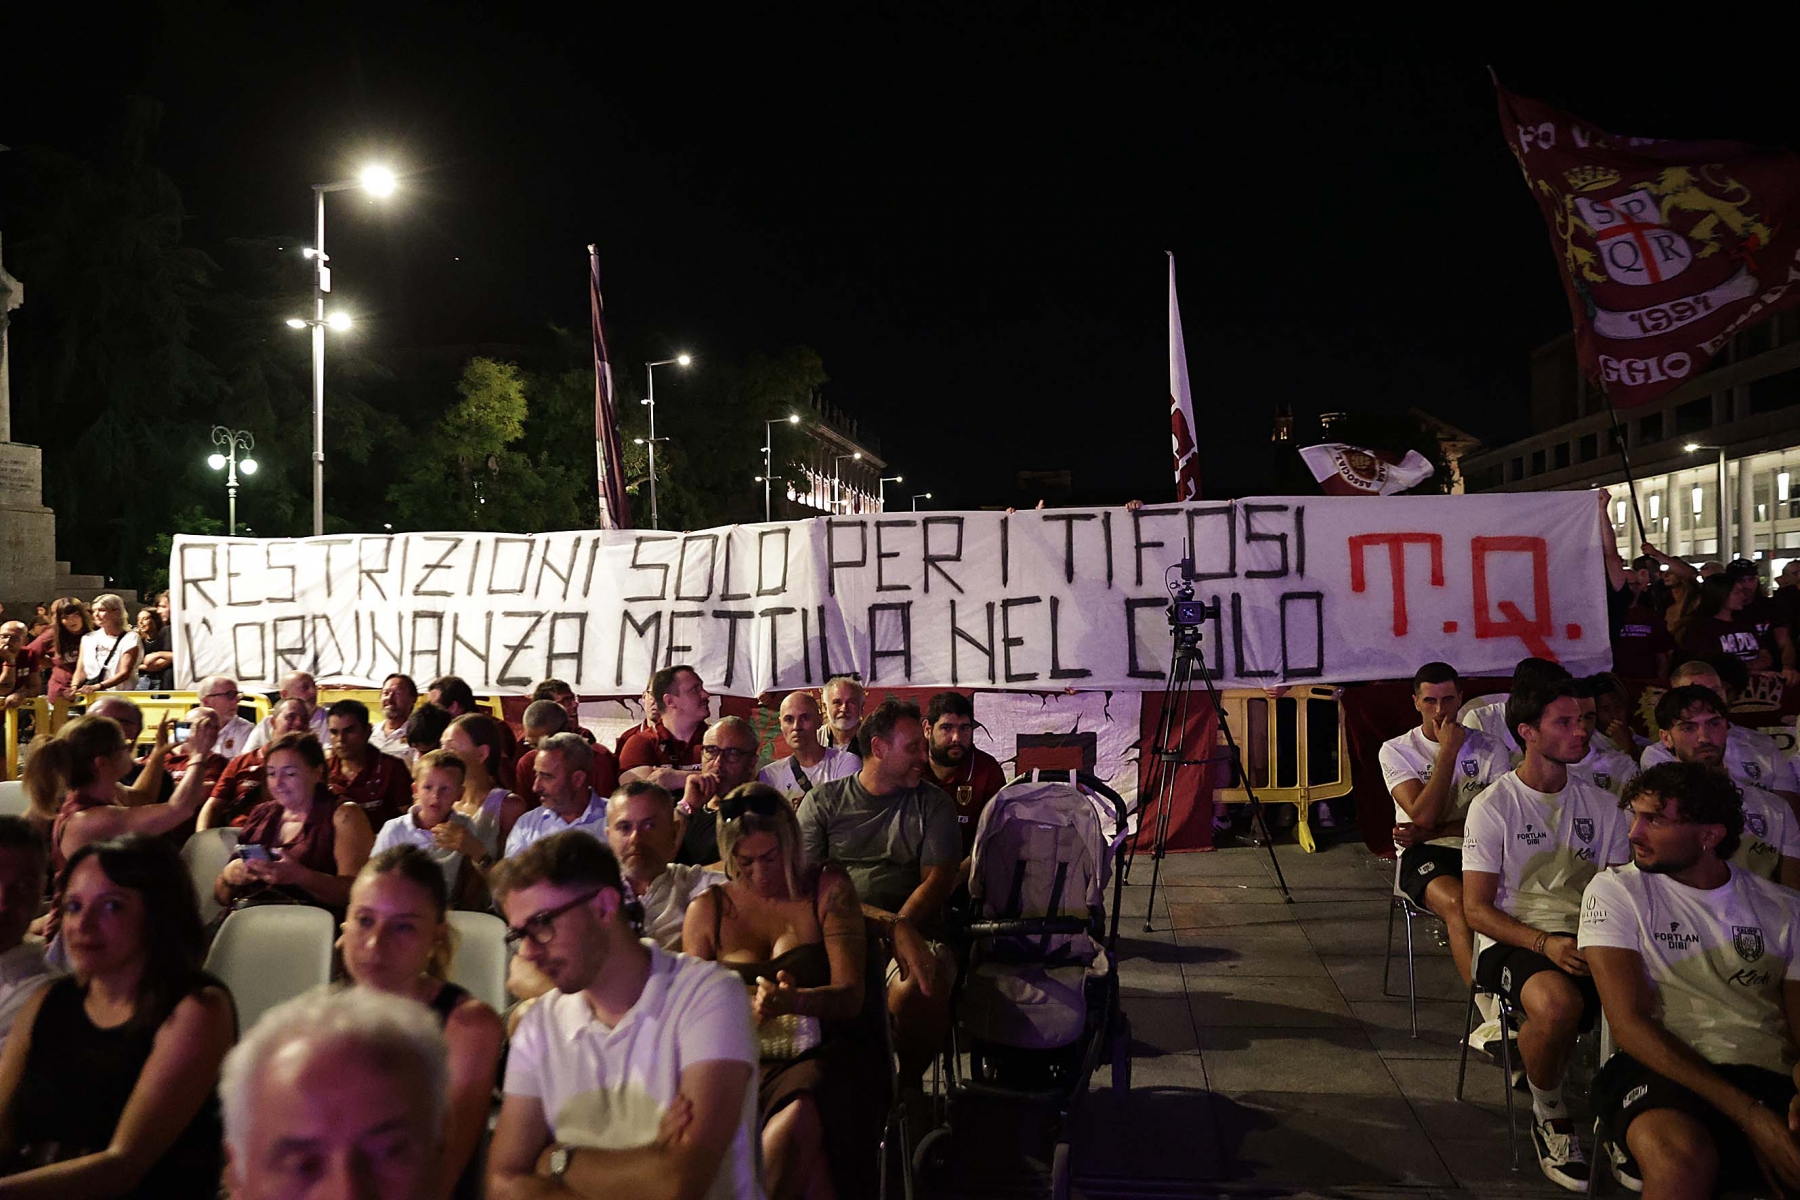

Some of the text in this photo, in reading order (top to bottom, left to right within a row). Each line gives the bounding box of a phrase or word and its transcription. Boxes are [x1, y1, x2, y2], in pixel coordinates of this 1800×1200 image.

[1598, 352, 1691, 386] GGIO
[1335, 454, 1372, 488] ASSOCIAZ
[180, 504, 1306, 612] RESTRIZIONI SOLO PER I TIFOSI
[1348, 532, 1583, 665] T.Q.
[184, 610, 589, 687] L'ORDINANZA
[616, 602, 914, 687] METTILA
[950, 596, 1094, 685] NEL
[1517, 831, 1547, 840] FORTLAN
[1654, 932, 1700, 944] FORTLAN
[1668, 941, 1688, 950] DIBI
